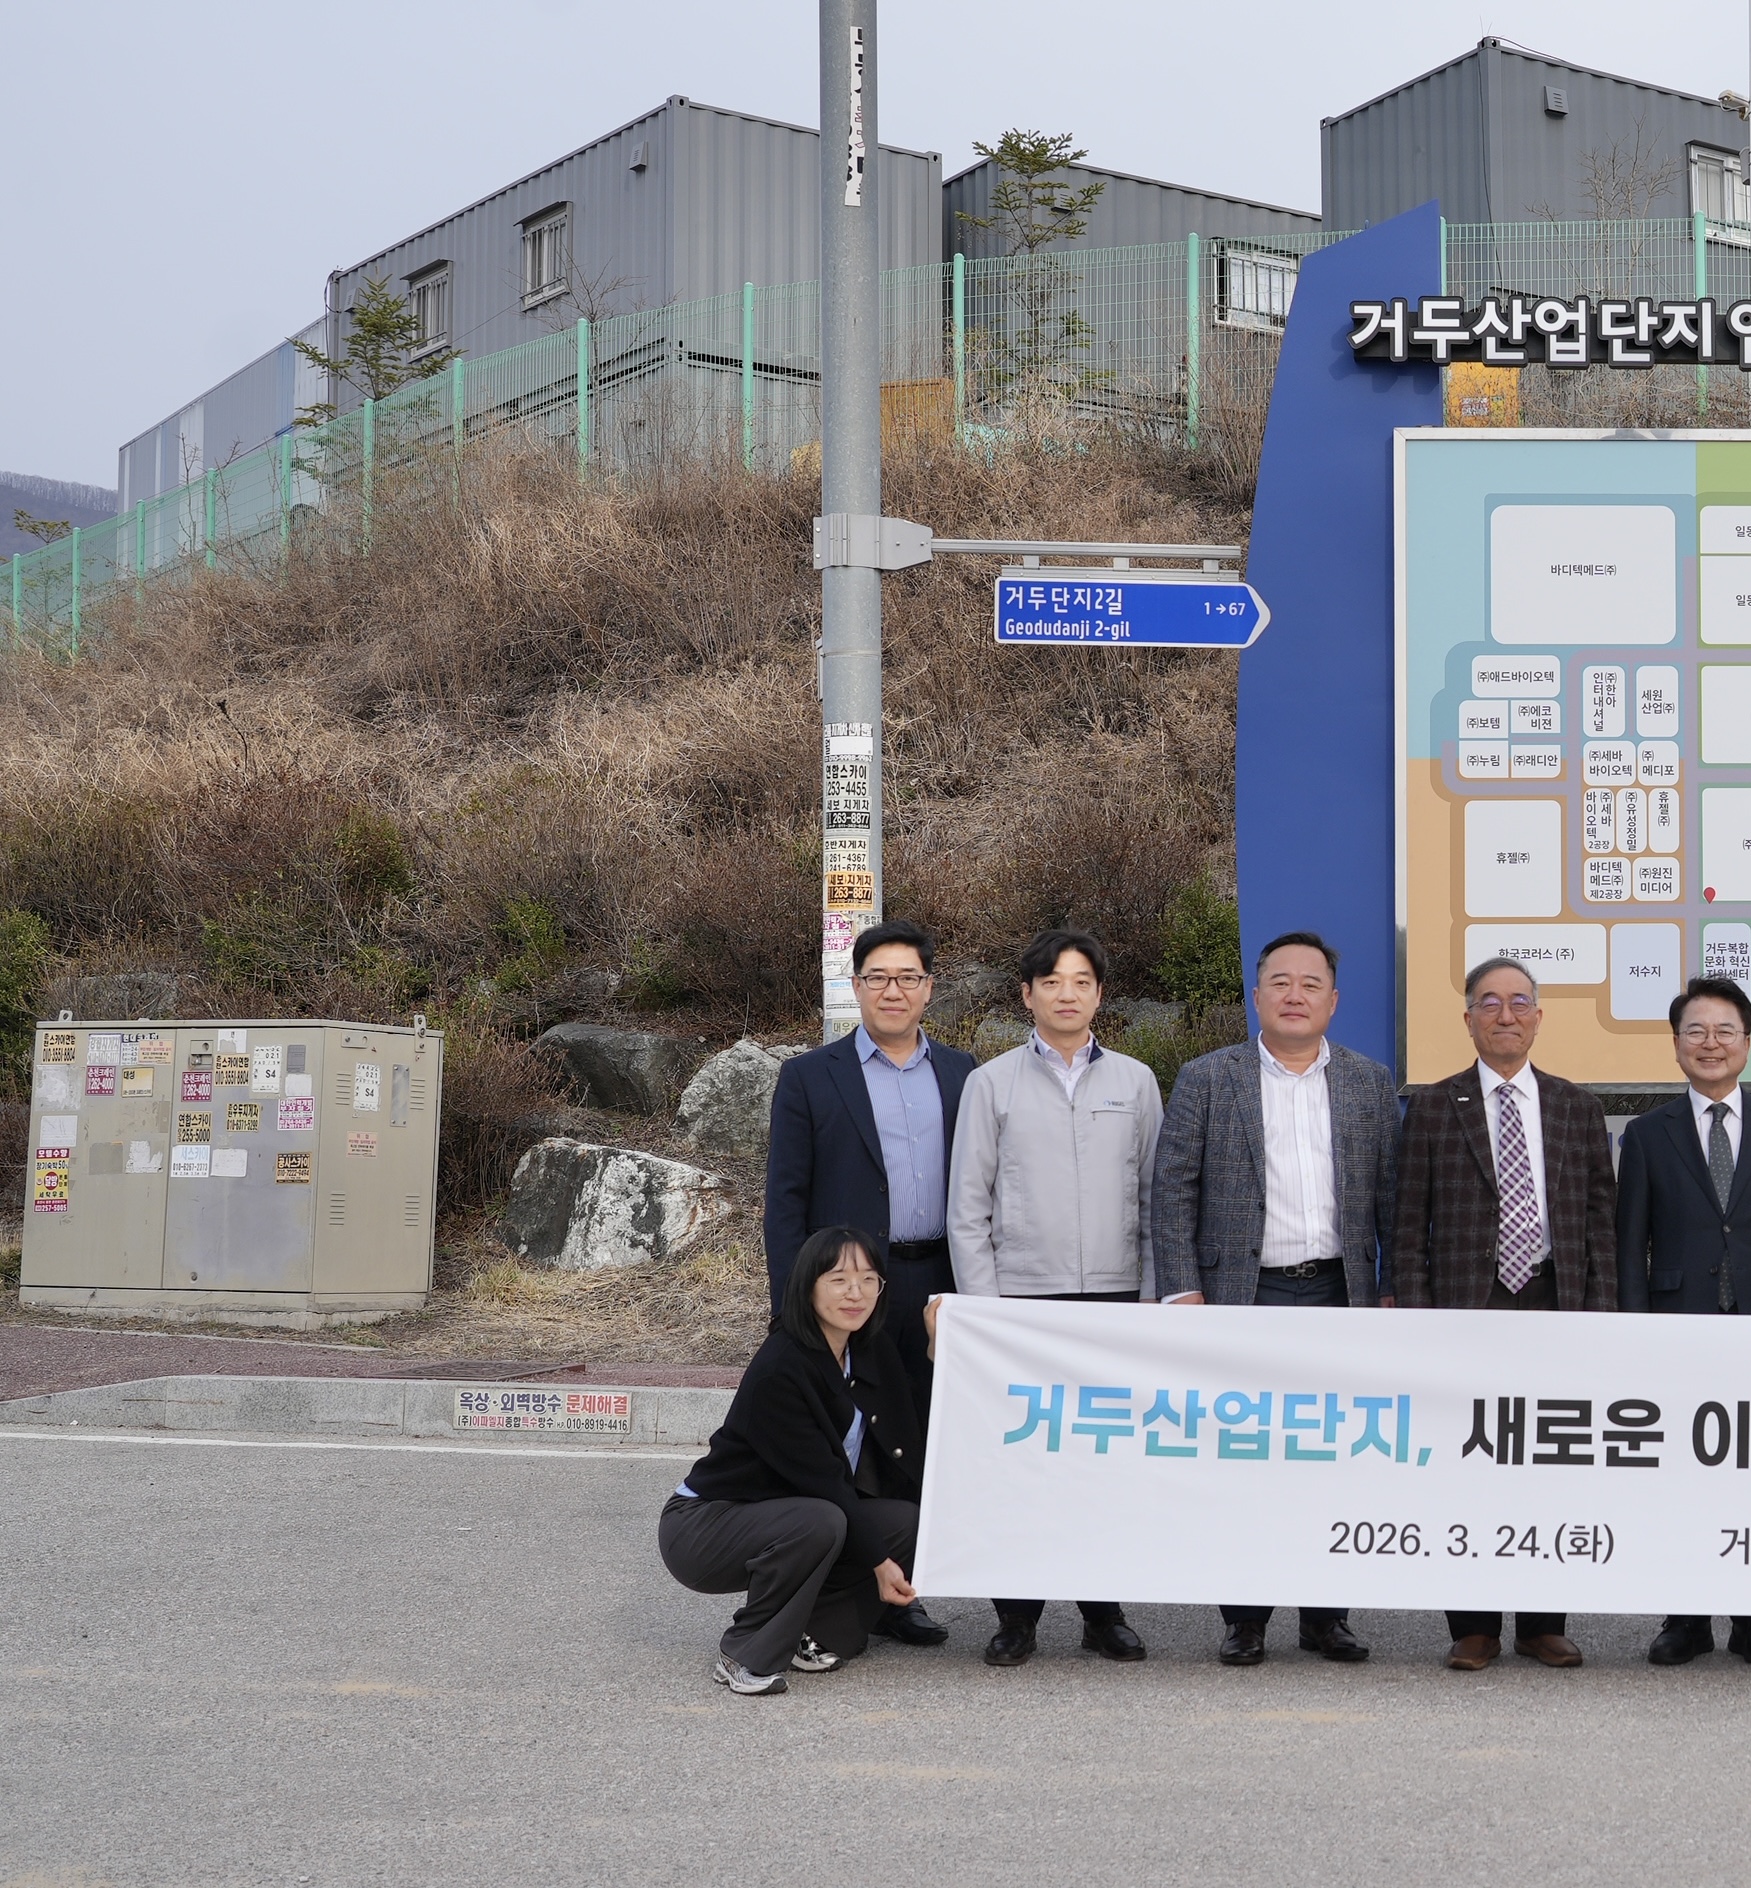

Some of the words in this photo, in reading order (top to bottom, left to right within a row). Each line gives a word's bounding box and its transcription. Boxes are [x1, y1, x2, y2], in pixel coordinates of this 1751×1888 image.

[1550, 564, 1617, 577] 바디텍메드㈜
[1006, 586, 1122, 616] 거두단지2길
[1005, 618, 1090, 639] Geodudanji
[1094, 620, 1131, 640] 2-gil
[1477, 670, 1554, 683] ㈜애드바이오텍
[1641, 689, 1663, 702] 세원
[1518, 705, 1552, 717] ㈜에코
[1641, 702, 1675, 715] 산업㈜
[1466, 754, 1500, 767] ㈜누림
[1513, 754, 1558, 767] ㈜래디안
[1588, 750, 1623, 762] ㈜세바
[1589, 764, 1632, 777] 바이오텍
[1642, 764, 1675, 777] 메디포
[1586, 791, 1597, 839] 바이오텍
[1588, 840, 1610, 850] 2공장
[1496, 851, 1530, 864] 휴젤㈜
[1589, 861, 1622, 874] 바디텍
[1639, 867, 1673, 880] ㈜원진
[1590, 874, 1624, 887] 메드㈜
[1640, 881, 1672, 894] 미디어
[1589, 889, 1623, 900] 제2공장
[1555, 948, 1575, 961] (주)
[1705, 942, 1749, 955] 거두복합
[1704, 955, 1726, 968] 문화
[1729, 955, 1750, 968] 혁신
[1629, 965, 1661, 978] 저수지
[265, 1069, 276, 1079] S4
[365, 1087, 375, 1097] S4
[566, 1394, 629, 1416] 문제해결
[566, 1418, 628, 1431] 010-8919-4416
[1003, 1383, 1433, 1467] 거두산업단지,
[1461, 1396, 1665, 1468] 새로운
[1328, 1521, 1430, 1557] 2026.
[1446, 1523, 1479, 1558] 3.
[1494, 1522, 1615, 1565] 24.(화)
